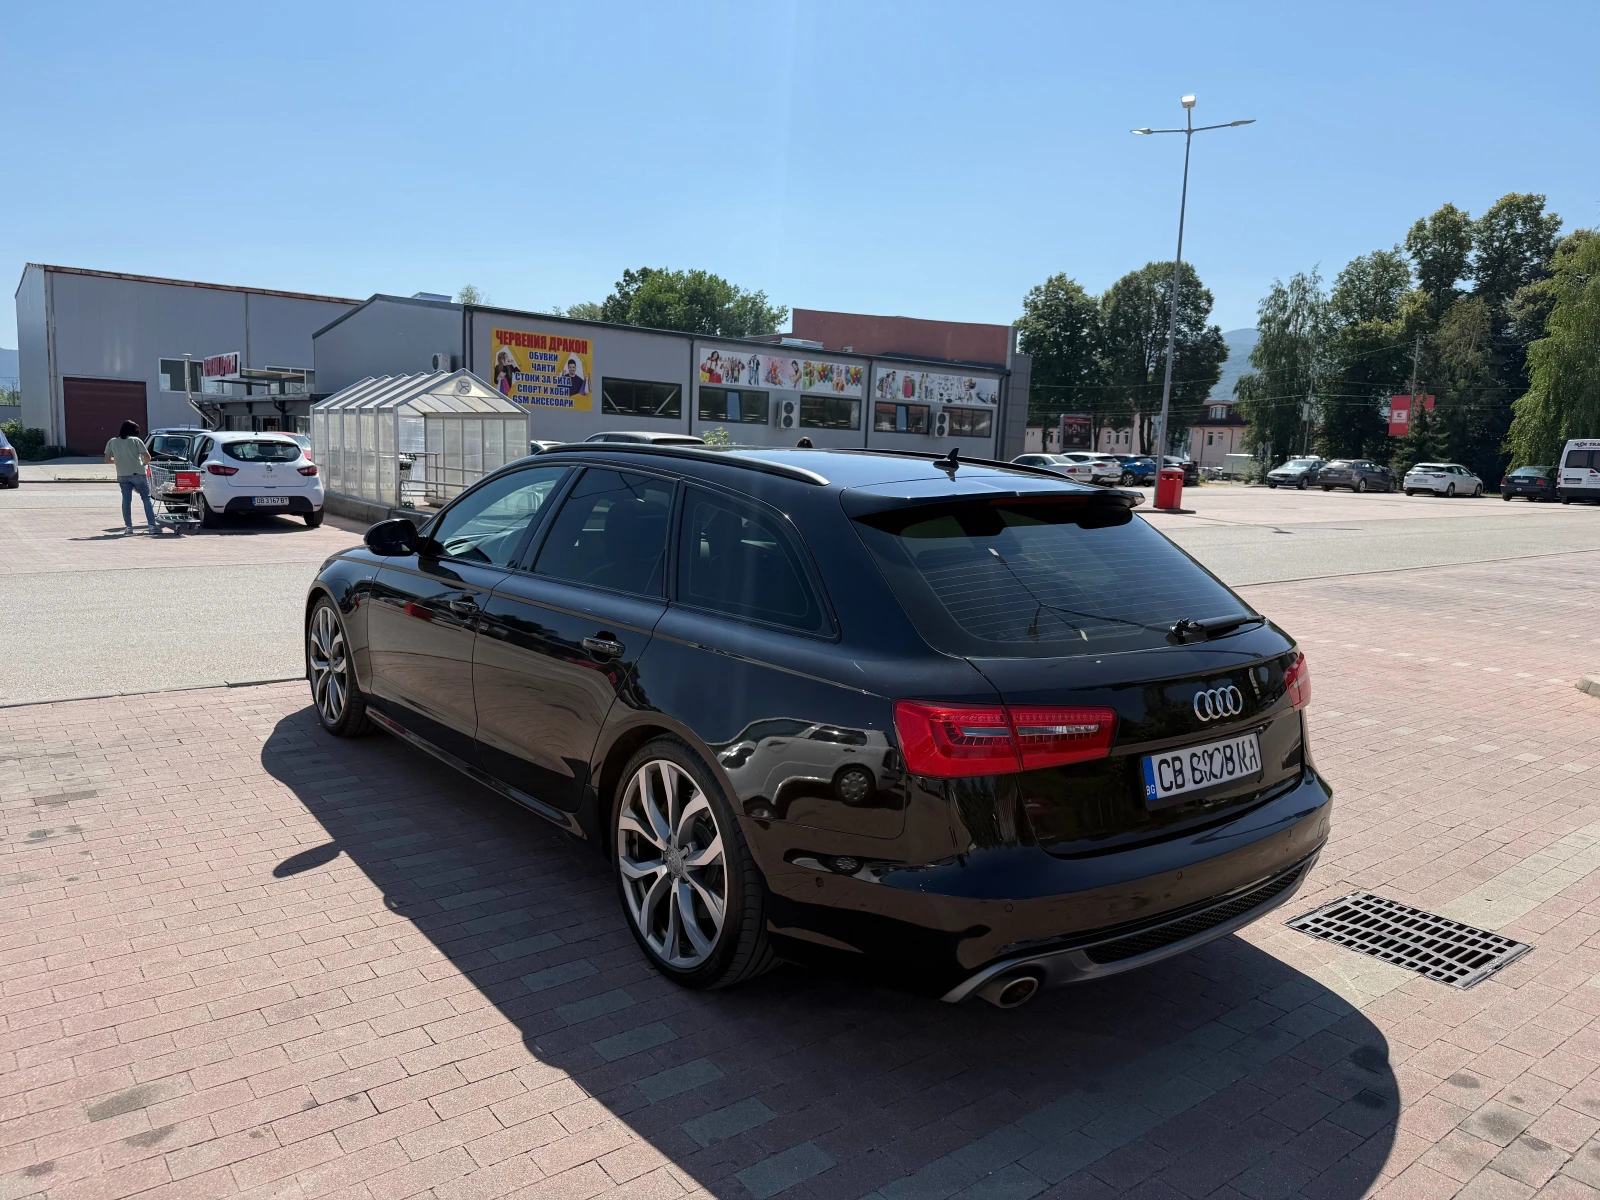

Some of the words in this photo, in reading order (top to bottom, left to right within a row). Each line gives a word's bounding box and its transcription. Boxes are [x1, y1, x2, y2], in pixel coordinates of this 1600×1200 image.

[496, 330, 547, 350] ЧЕРВЕНИЯ
[549, 337, 588, 354] ДРАКОН
[529, 351, 559, 362] ОБУВКИ
[532, 363, 556, 373] ЧАНТИ
[515, 373, 540, 383] СТОКИ
[542, 376, 551, 384] ЗА
[553, 377, 571, 385] БИТА
[517, 384, 541, 394] СПОРТ
[543, 386, 548, 394] И
[550, 387, 569, 396] ХОБИ
[513, 395, 530, 404] GSM
[531, 397, 574, 407] АКСЕСОАРИ
[1158, 756, 1185, 792] CB
[1146, 784, 1156, 796] BG
